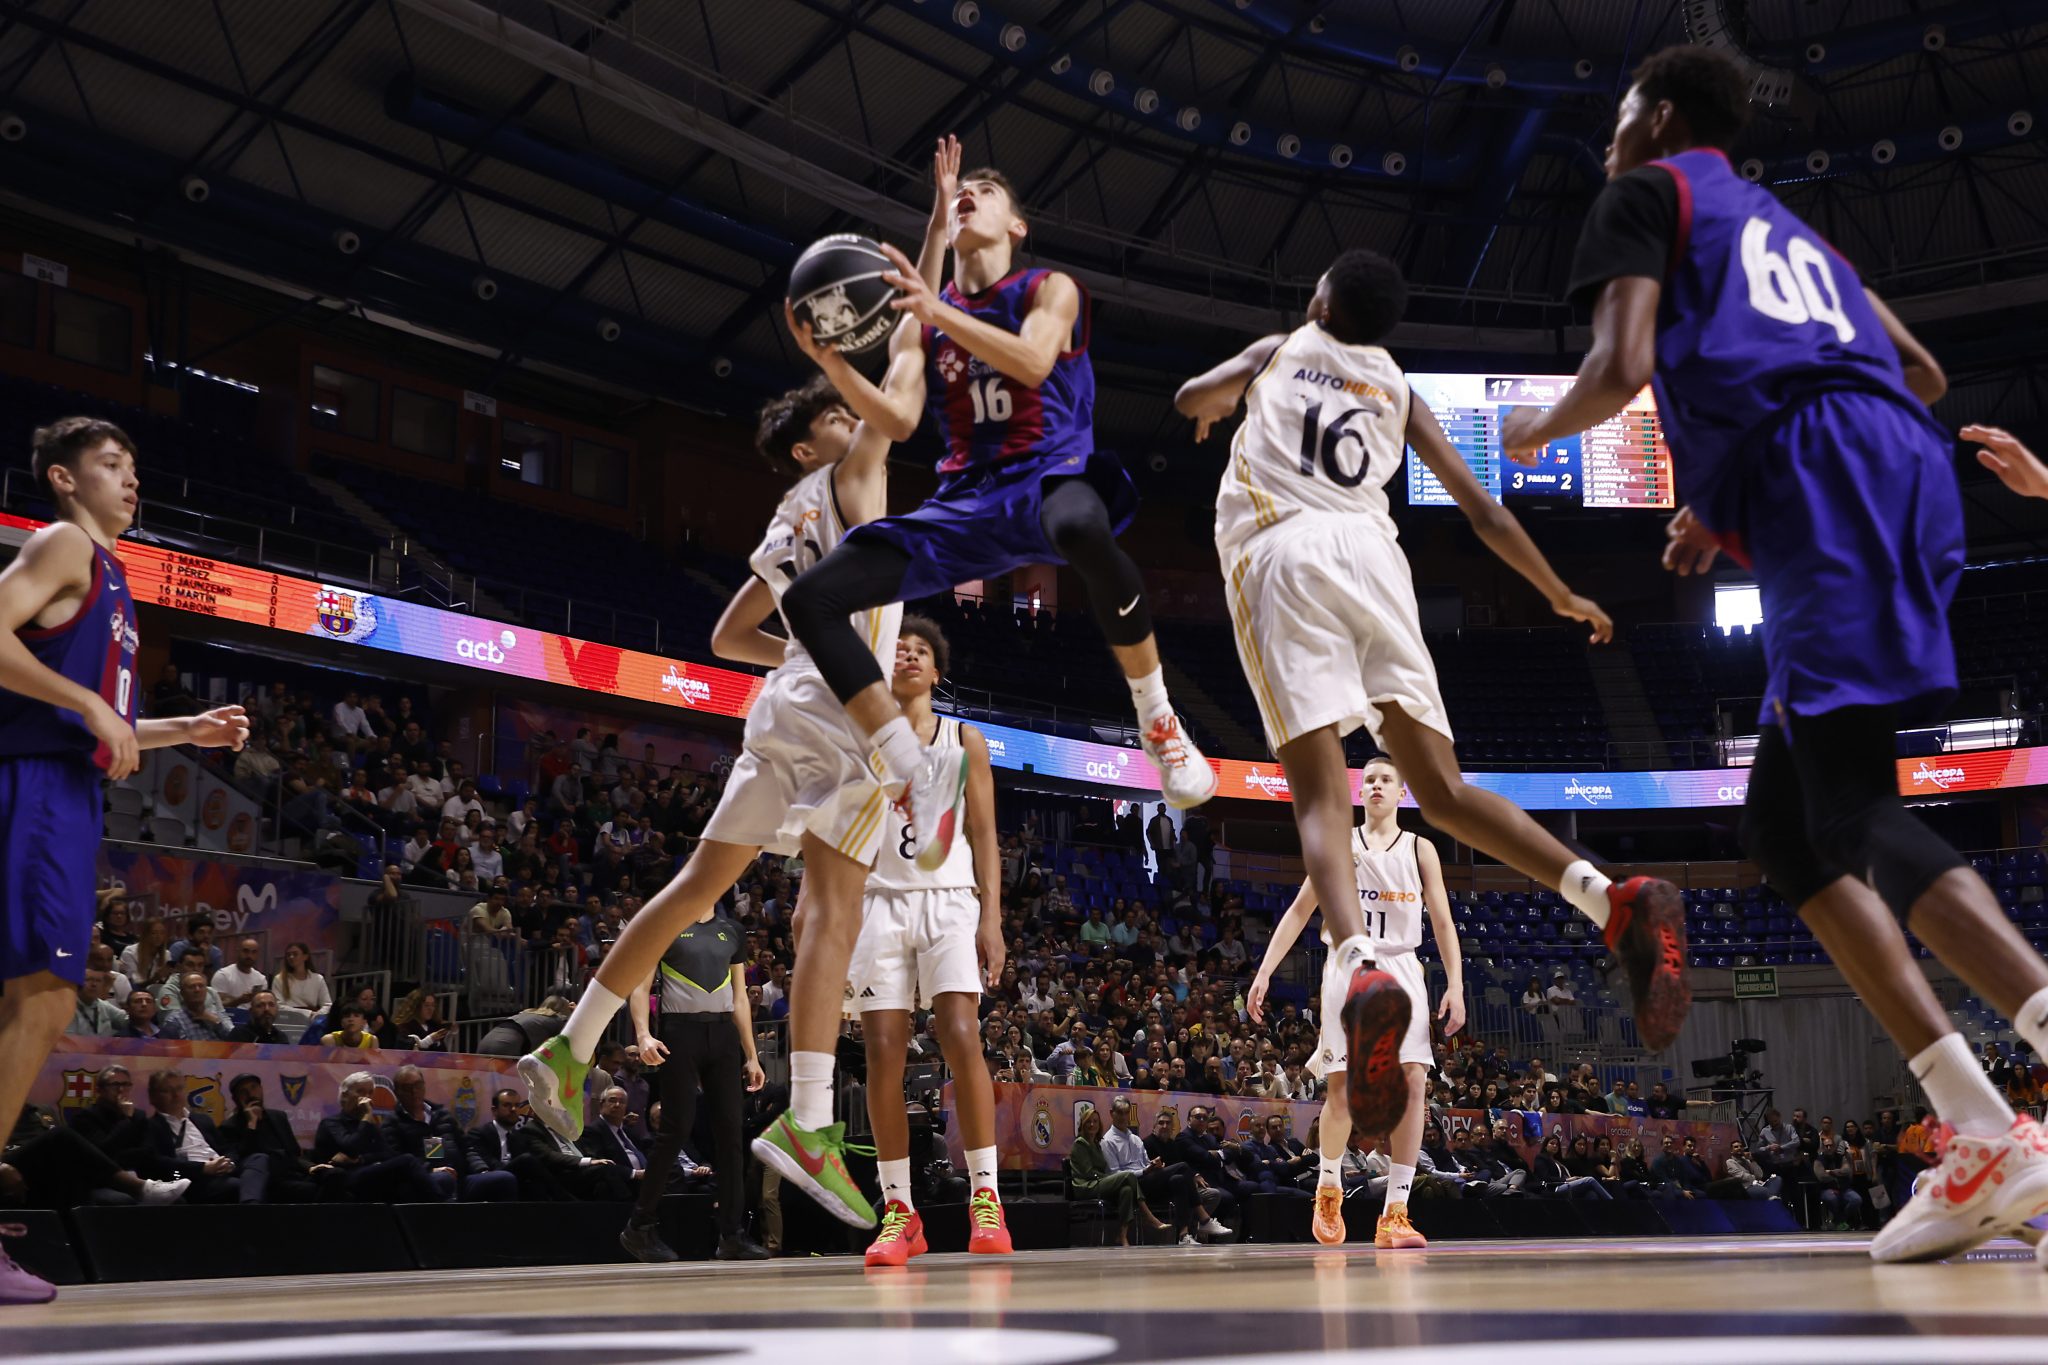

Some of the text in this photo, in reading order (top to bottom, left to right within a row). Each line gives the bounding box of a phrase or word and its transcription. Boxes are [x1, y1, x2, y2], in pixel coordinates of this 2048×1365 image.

[1741, 216, 1856, 343] 60
[1293, 368, 1392, 403] AUTOHERO
[1491, 380, 1513, 397] 17
[968, 378, 1013, 424] 16
[1300, 402, 1381, 488] 16
[1512, 472, 1524, 489] 3
[1560, 473, 1573, 490] 2
[161, 562, 173, 573] 10
[271, 585, 278, 595] 0
[159, 584, 171, 595] 16
[269, 606, 276, 616] 0
[175, 598, 217, 615] DABONE
[271, 596, 277, 606] 0
[456, 639, 505, 664] acb
[1086, 760, 1120, 779] acb
[899, 823, 917, 860] 8
[1357, 889, 1416, 903] TOHERO
[1364, 909, 1386, 939] 11
